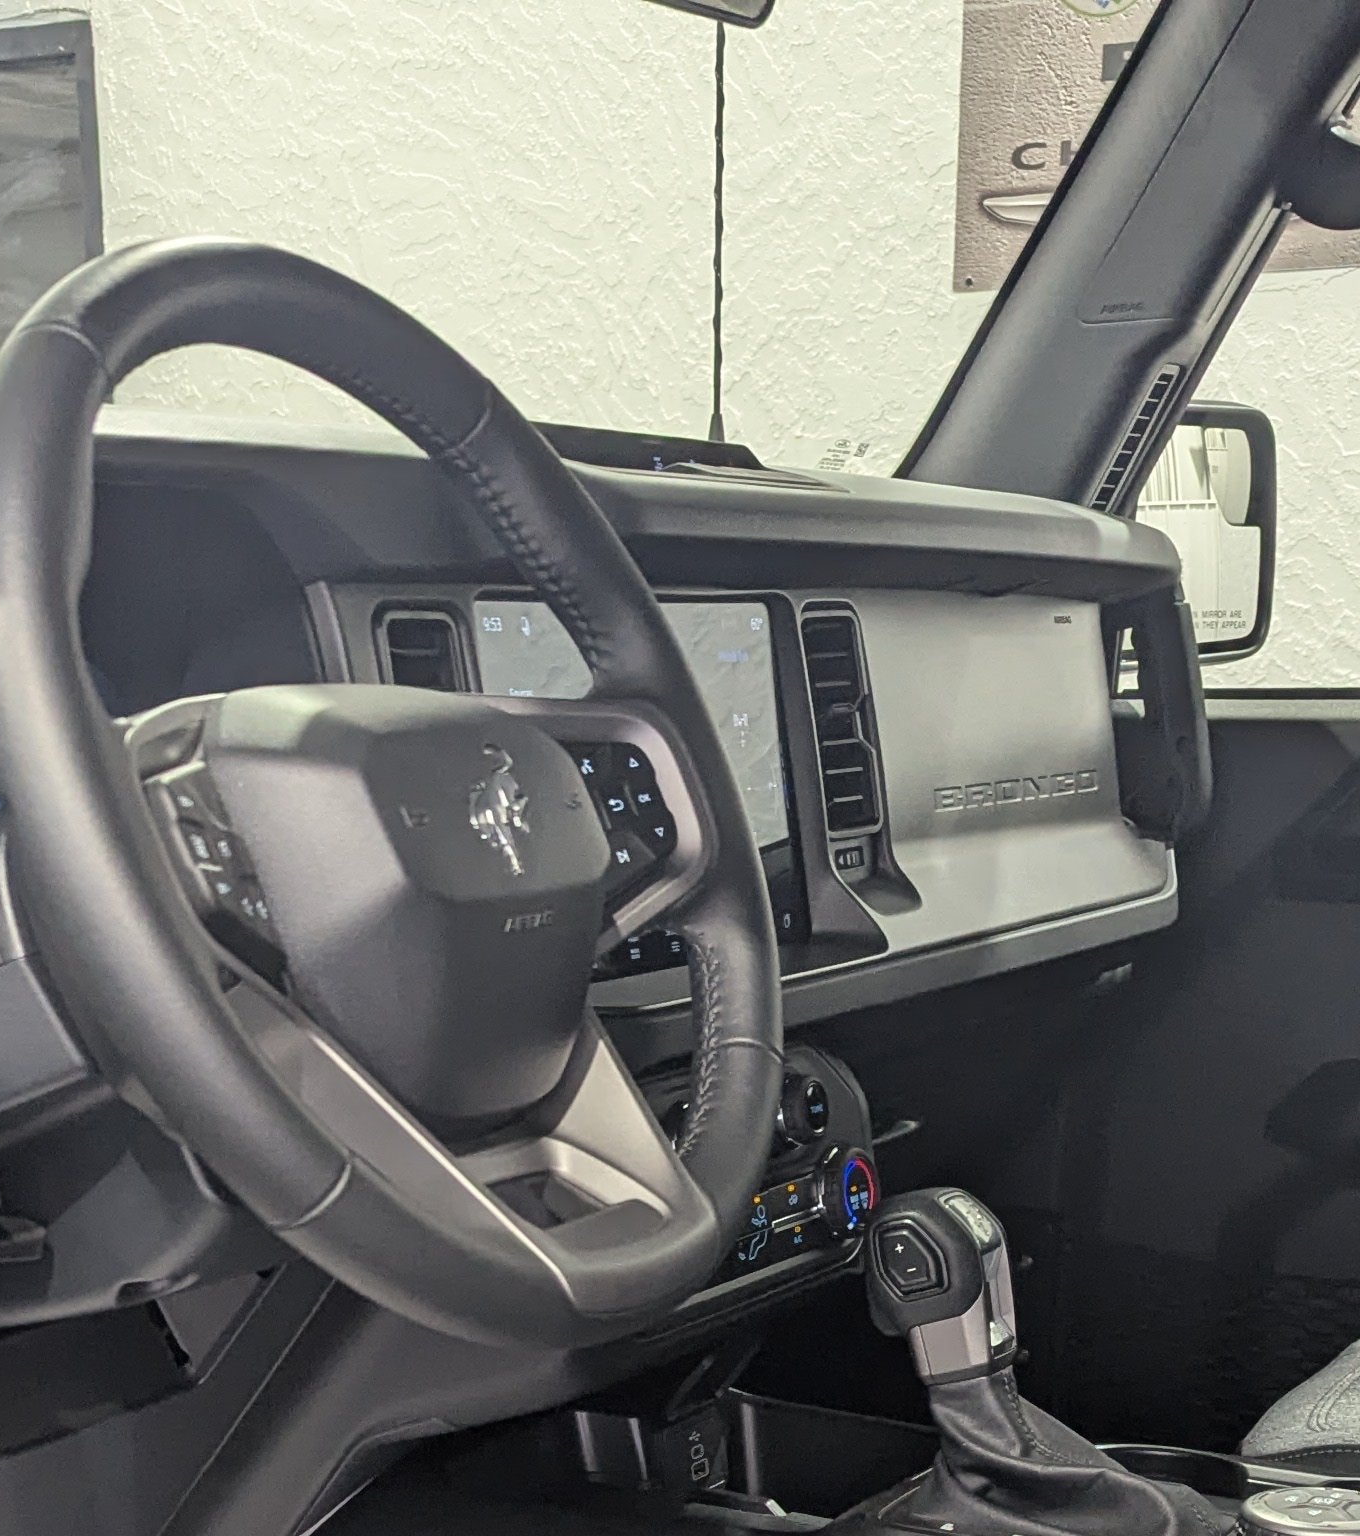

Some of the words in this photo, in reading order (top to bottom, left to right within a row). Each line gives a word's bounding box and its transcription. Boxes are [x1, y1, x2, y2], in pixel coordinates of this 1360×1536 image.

[1201, 610, 1227, 619] MIRROR
[1230, 610, 1242, 619] ARE
[1202, 620, 1218, 630] THEY
[1221, 620, 1246, 630] APPEAR
[933, 768, 1100, 813] BRONCO
